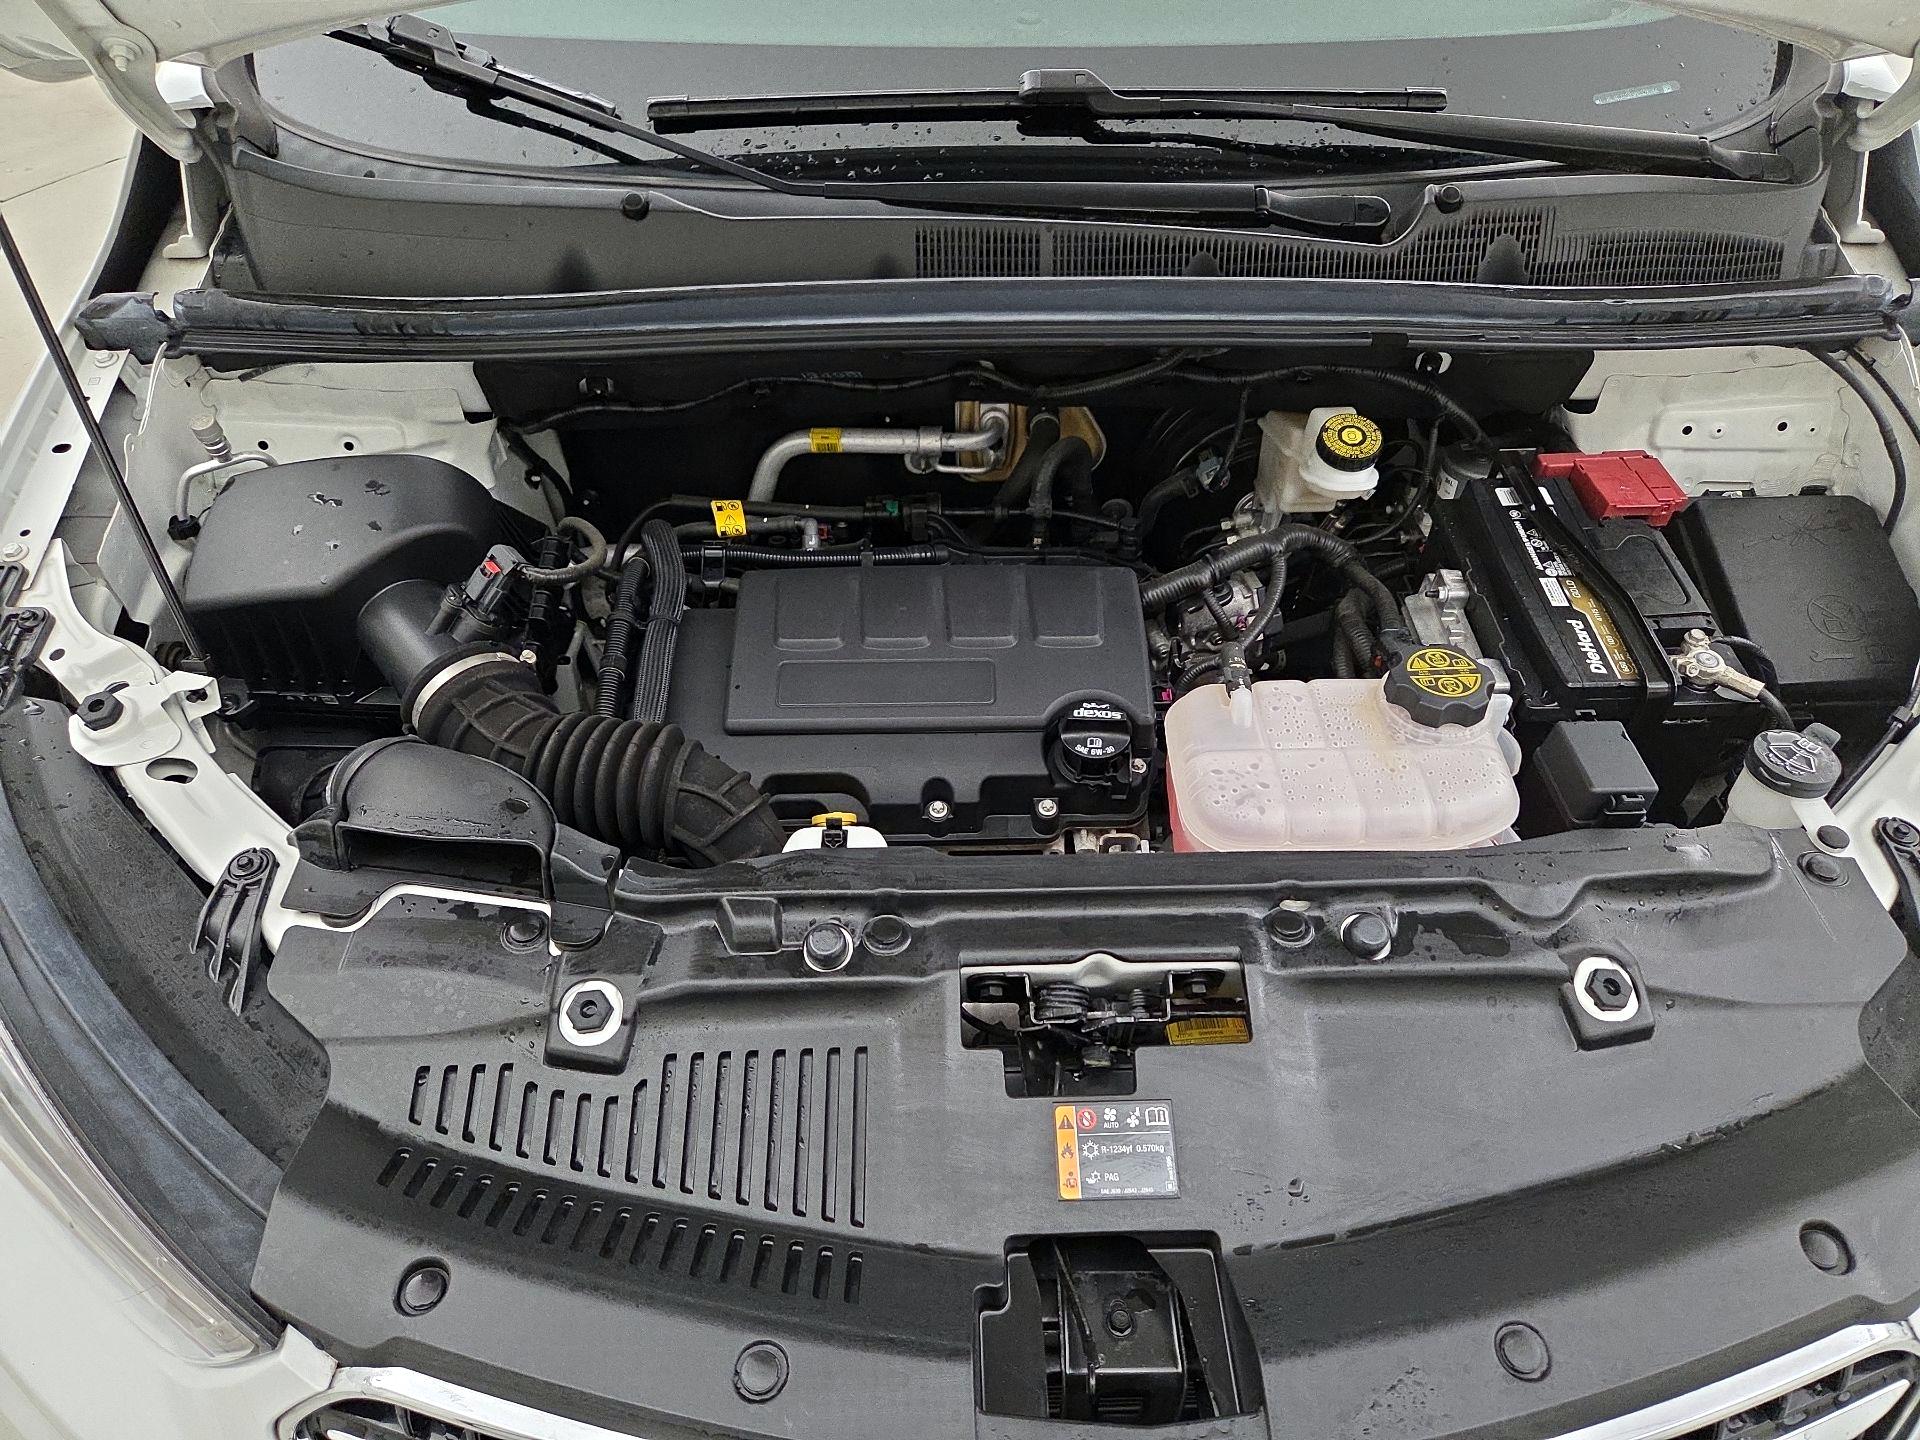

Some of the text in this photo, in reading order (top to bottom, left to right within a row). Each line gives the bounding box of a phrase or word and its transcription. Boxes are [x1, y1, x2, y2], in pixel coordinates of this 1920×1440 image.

[1565, 579, 1582, 599] GOLD
[1566, 619, 1608, 675] DieHard
[1073, 708, 1123, 719] dexos
[1103, 1121, 1120, 1129] AUTO
[1136, 1144, 1165, 1153] 0.570kg
[1104, 1172, 1120, 1182] PAG
